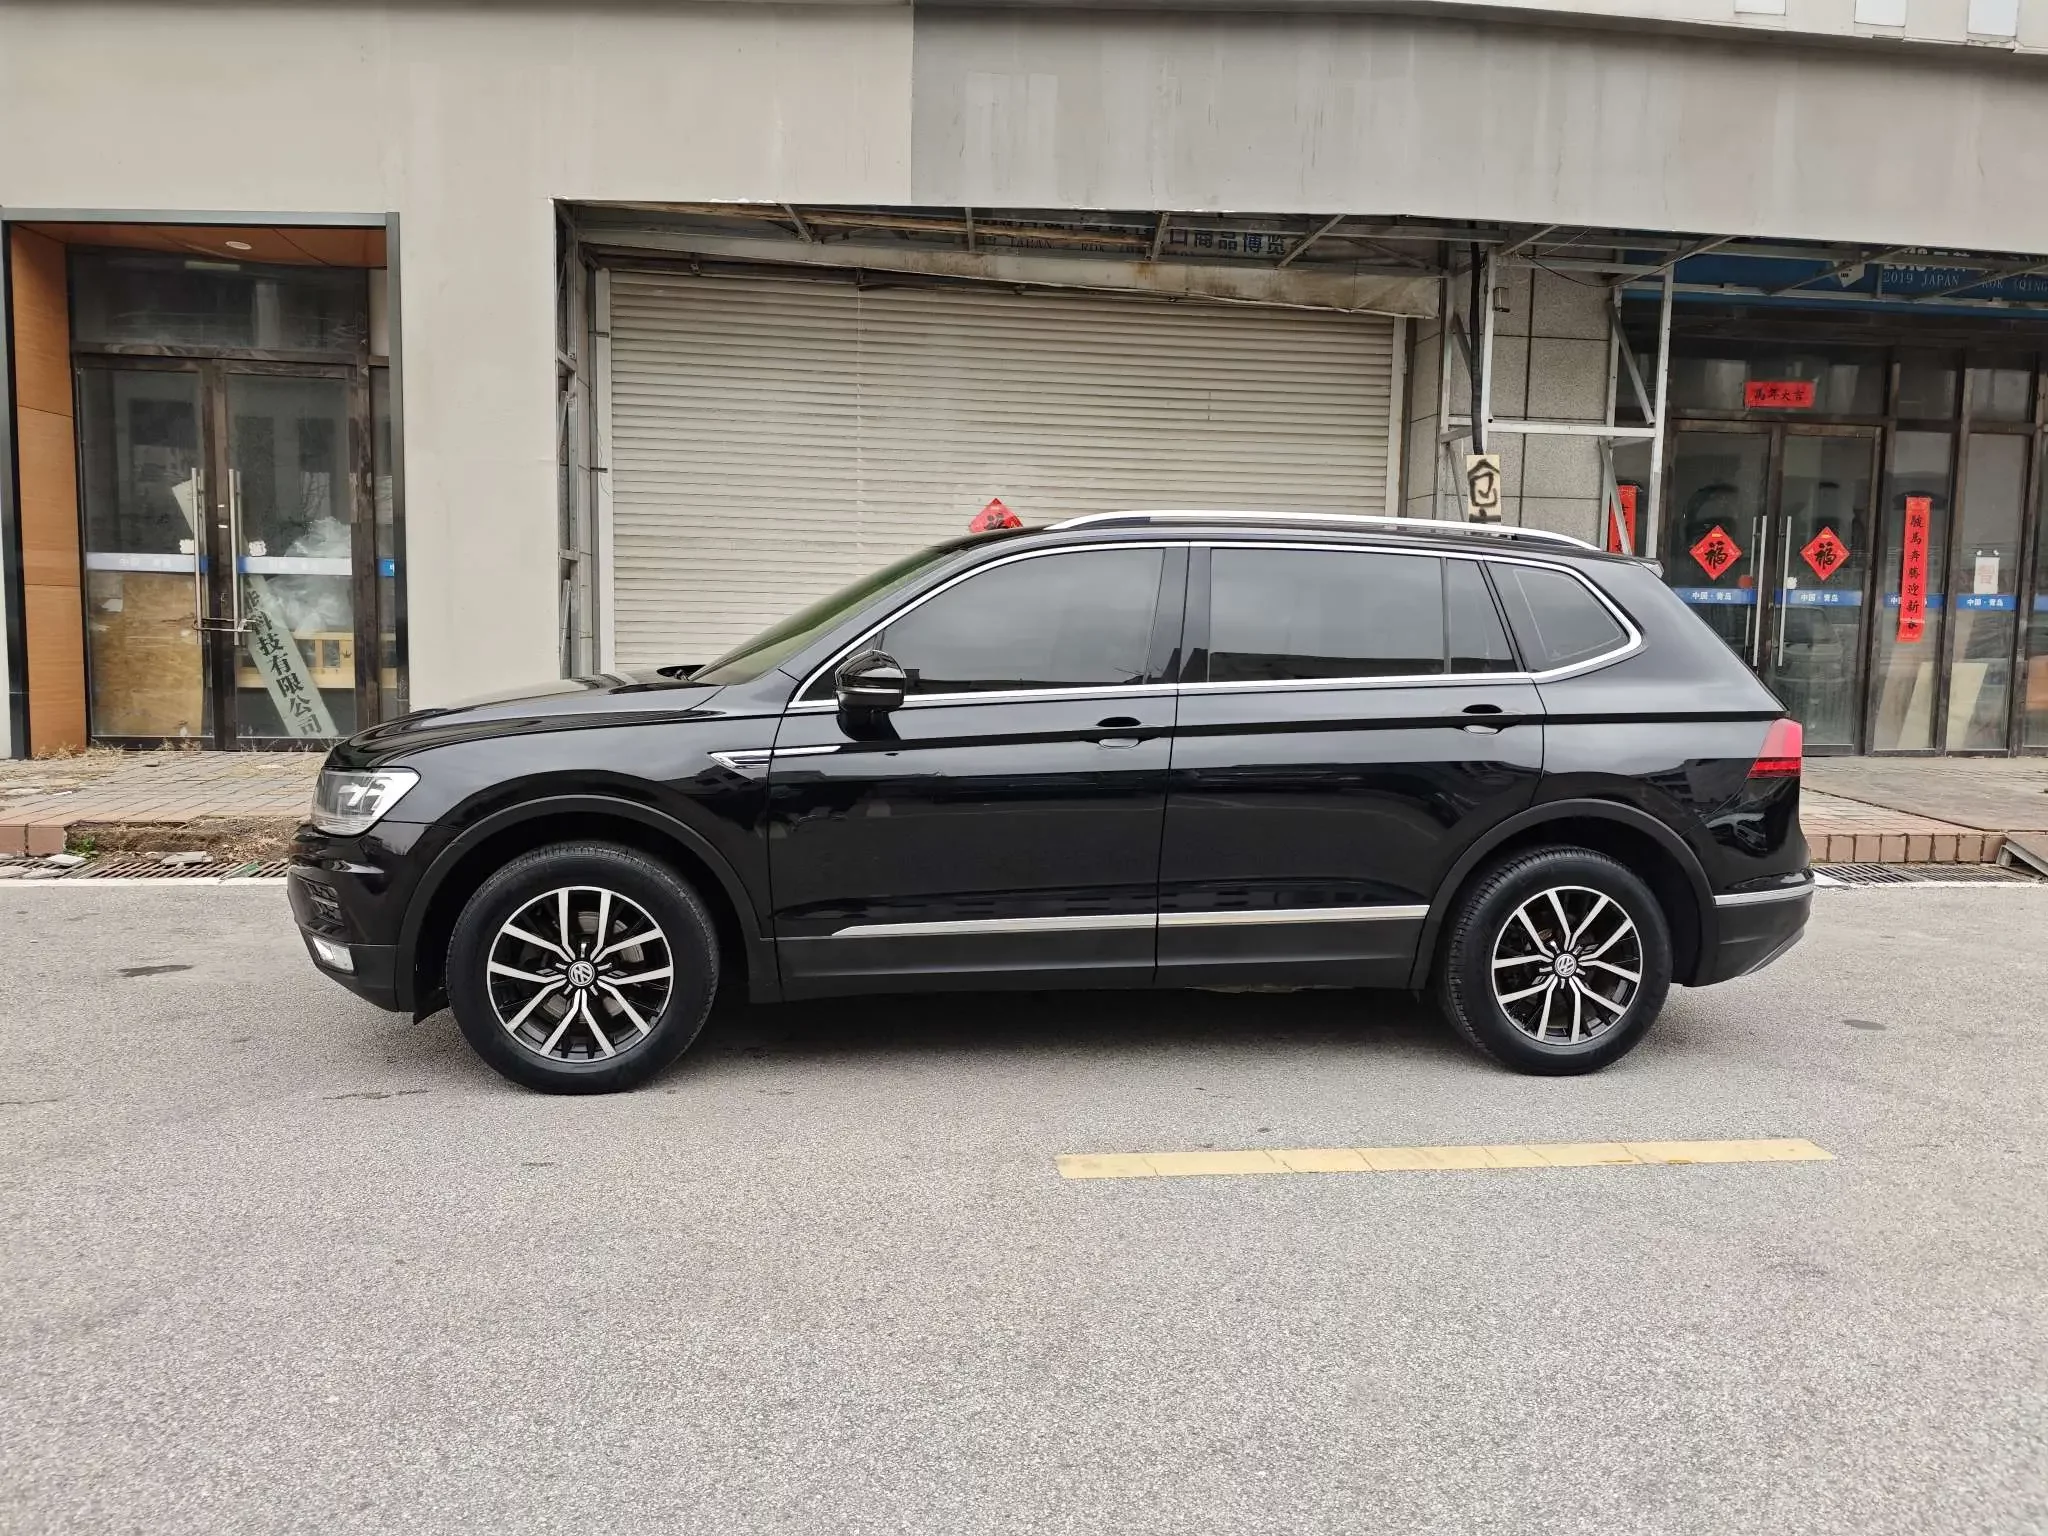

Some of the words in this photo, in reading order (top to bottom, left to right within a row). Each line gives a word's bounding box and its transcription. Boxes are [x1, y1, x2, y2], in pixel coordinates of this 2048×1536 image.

[1883, 271, 1913, 284] 2019
[1921, 274, 1960, 287] JAPAN
[1467, 458, 1501, 523] 仓
[1705, 540, 1729, 570] 福
[1814, 541, 1837, 570] 福
